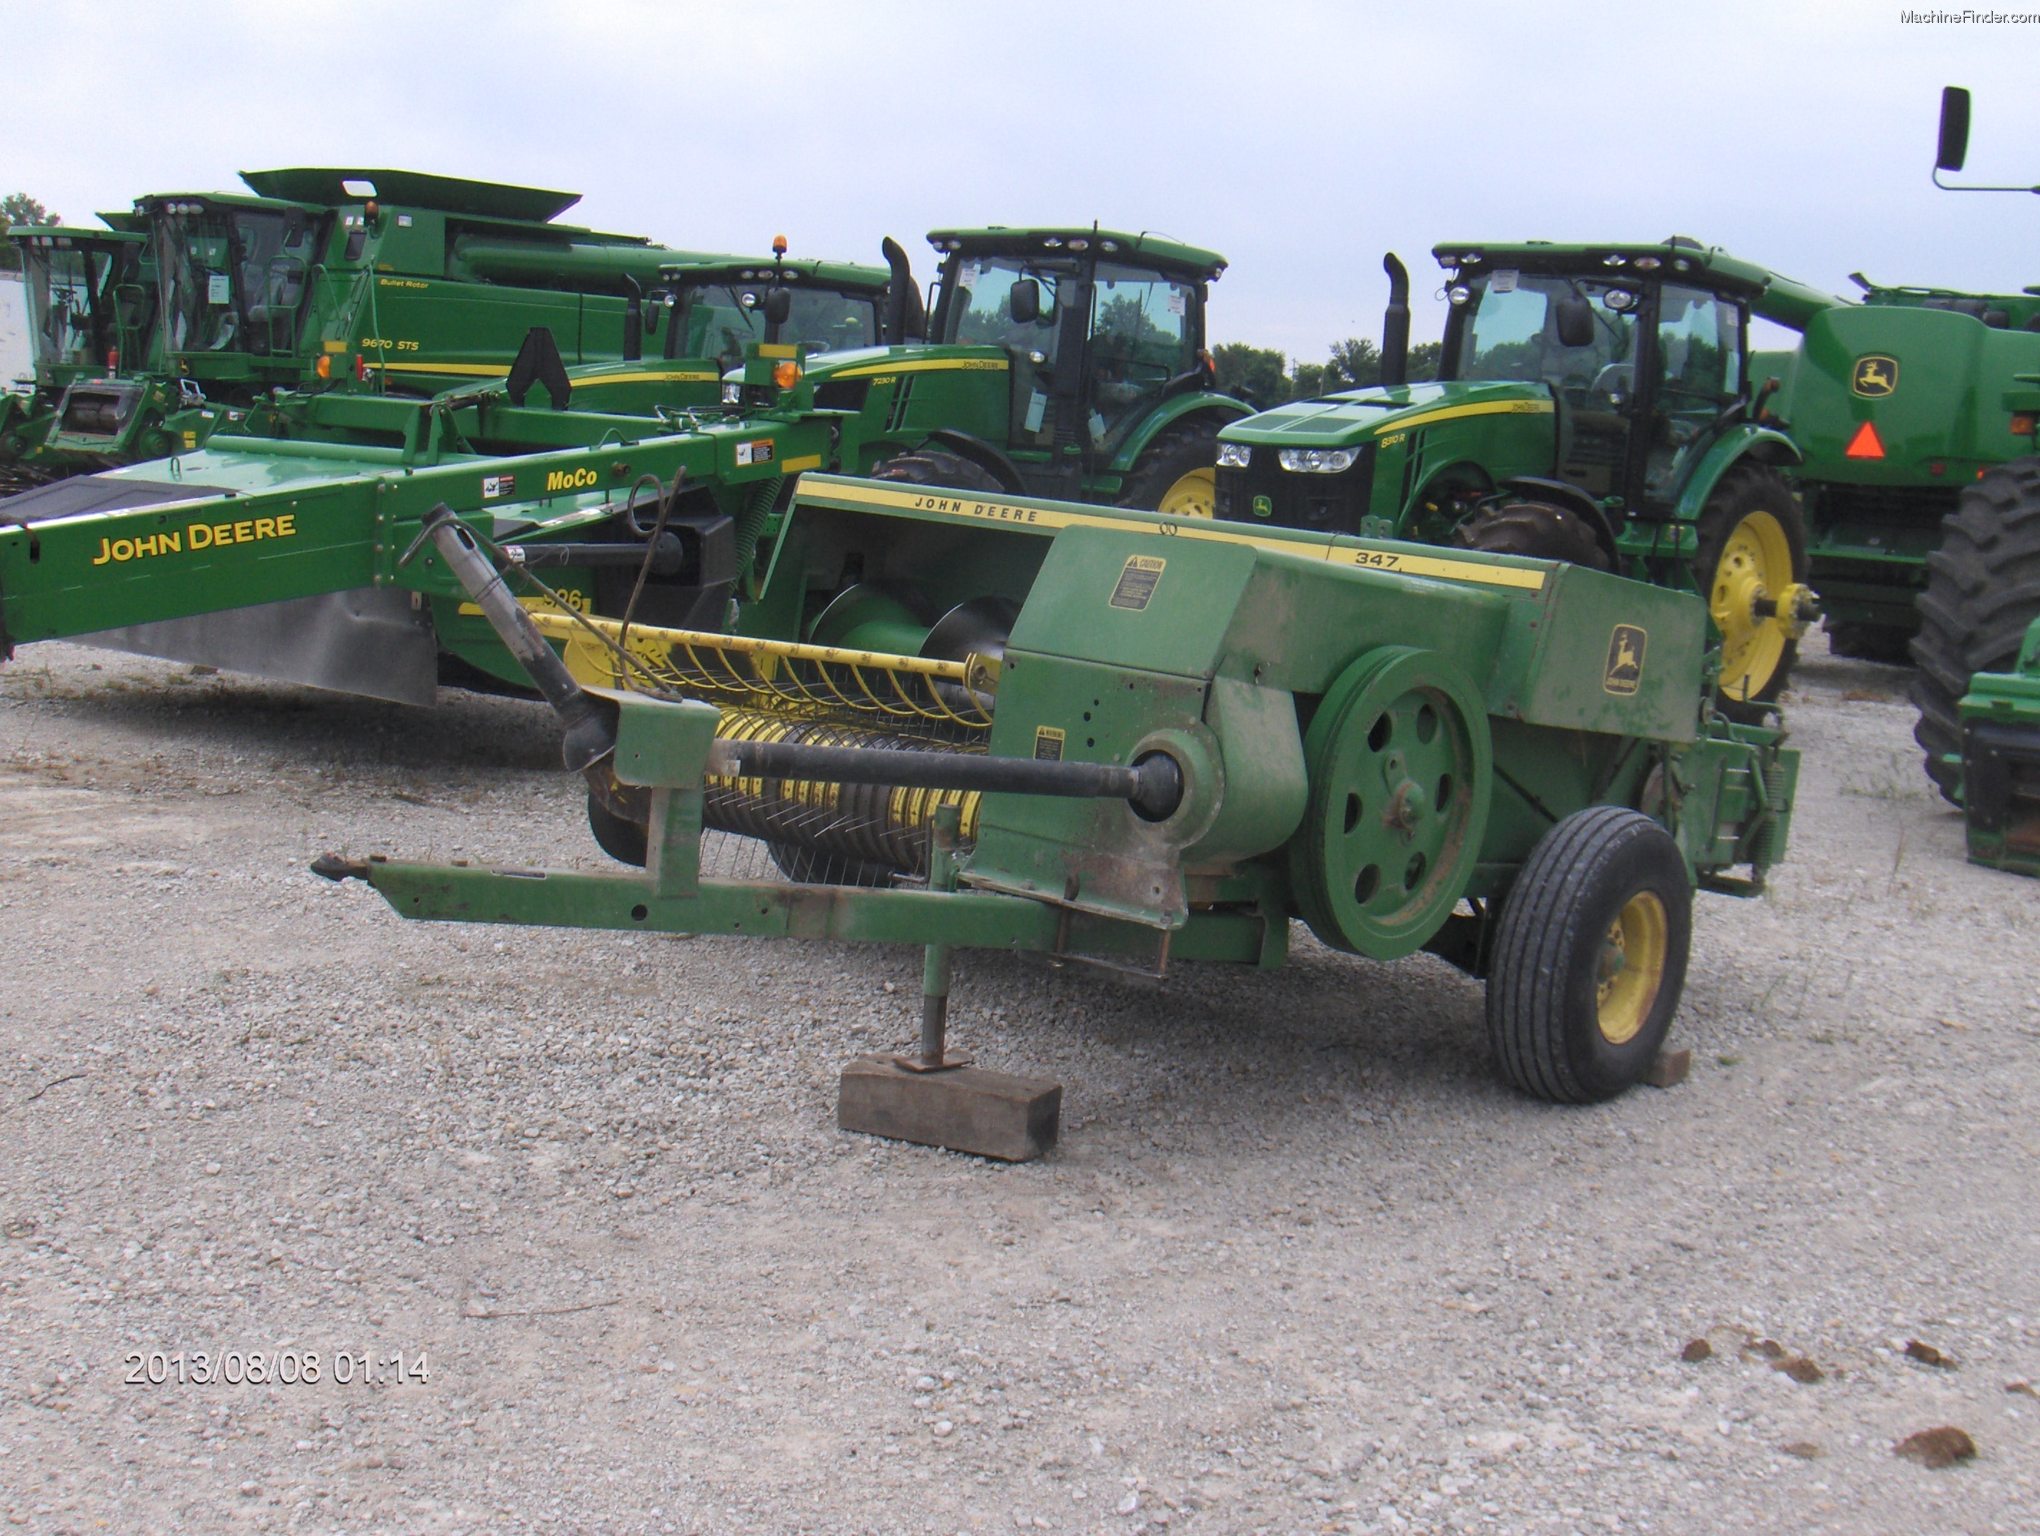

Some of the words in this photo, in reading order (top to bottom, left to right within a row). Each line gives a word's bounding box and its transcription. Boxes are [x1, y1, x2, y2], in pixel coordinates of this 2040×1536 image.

[380, 278, 404, 287] Bullet
[406, 281, 429, 289] Rotor
[362, 338, 393, 349] 9670
[397, 340, 419, 351] STS
[547, 467, 597, 491] MoCo
[915, 497, 961, 512] JOHN
[974, 504, 1037, 522] DEERE
[92, 530, 182, 566] JOHN
[188, 514, 297, 551] DEERE
[1356, 551, 1399, 568] 347
